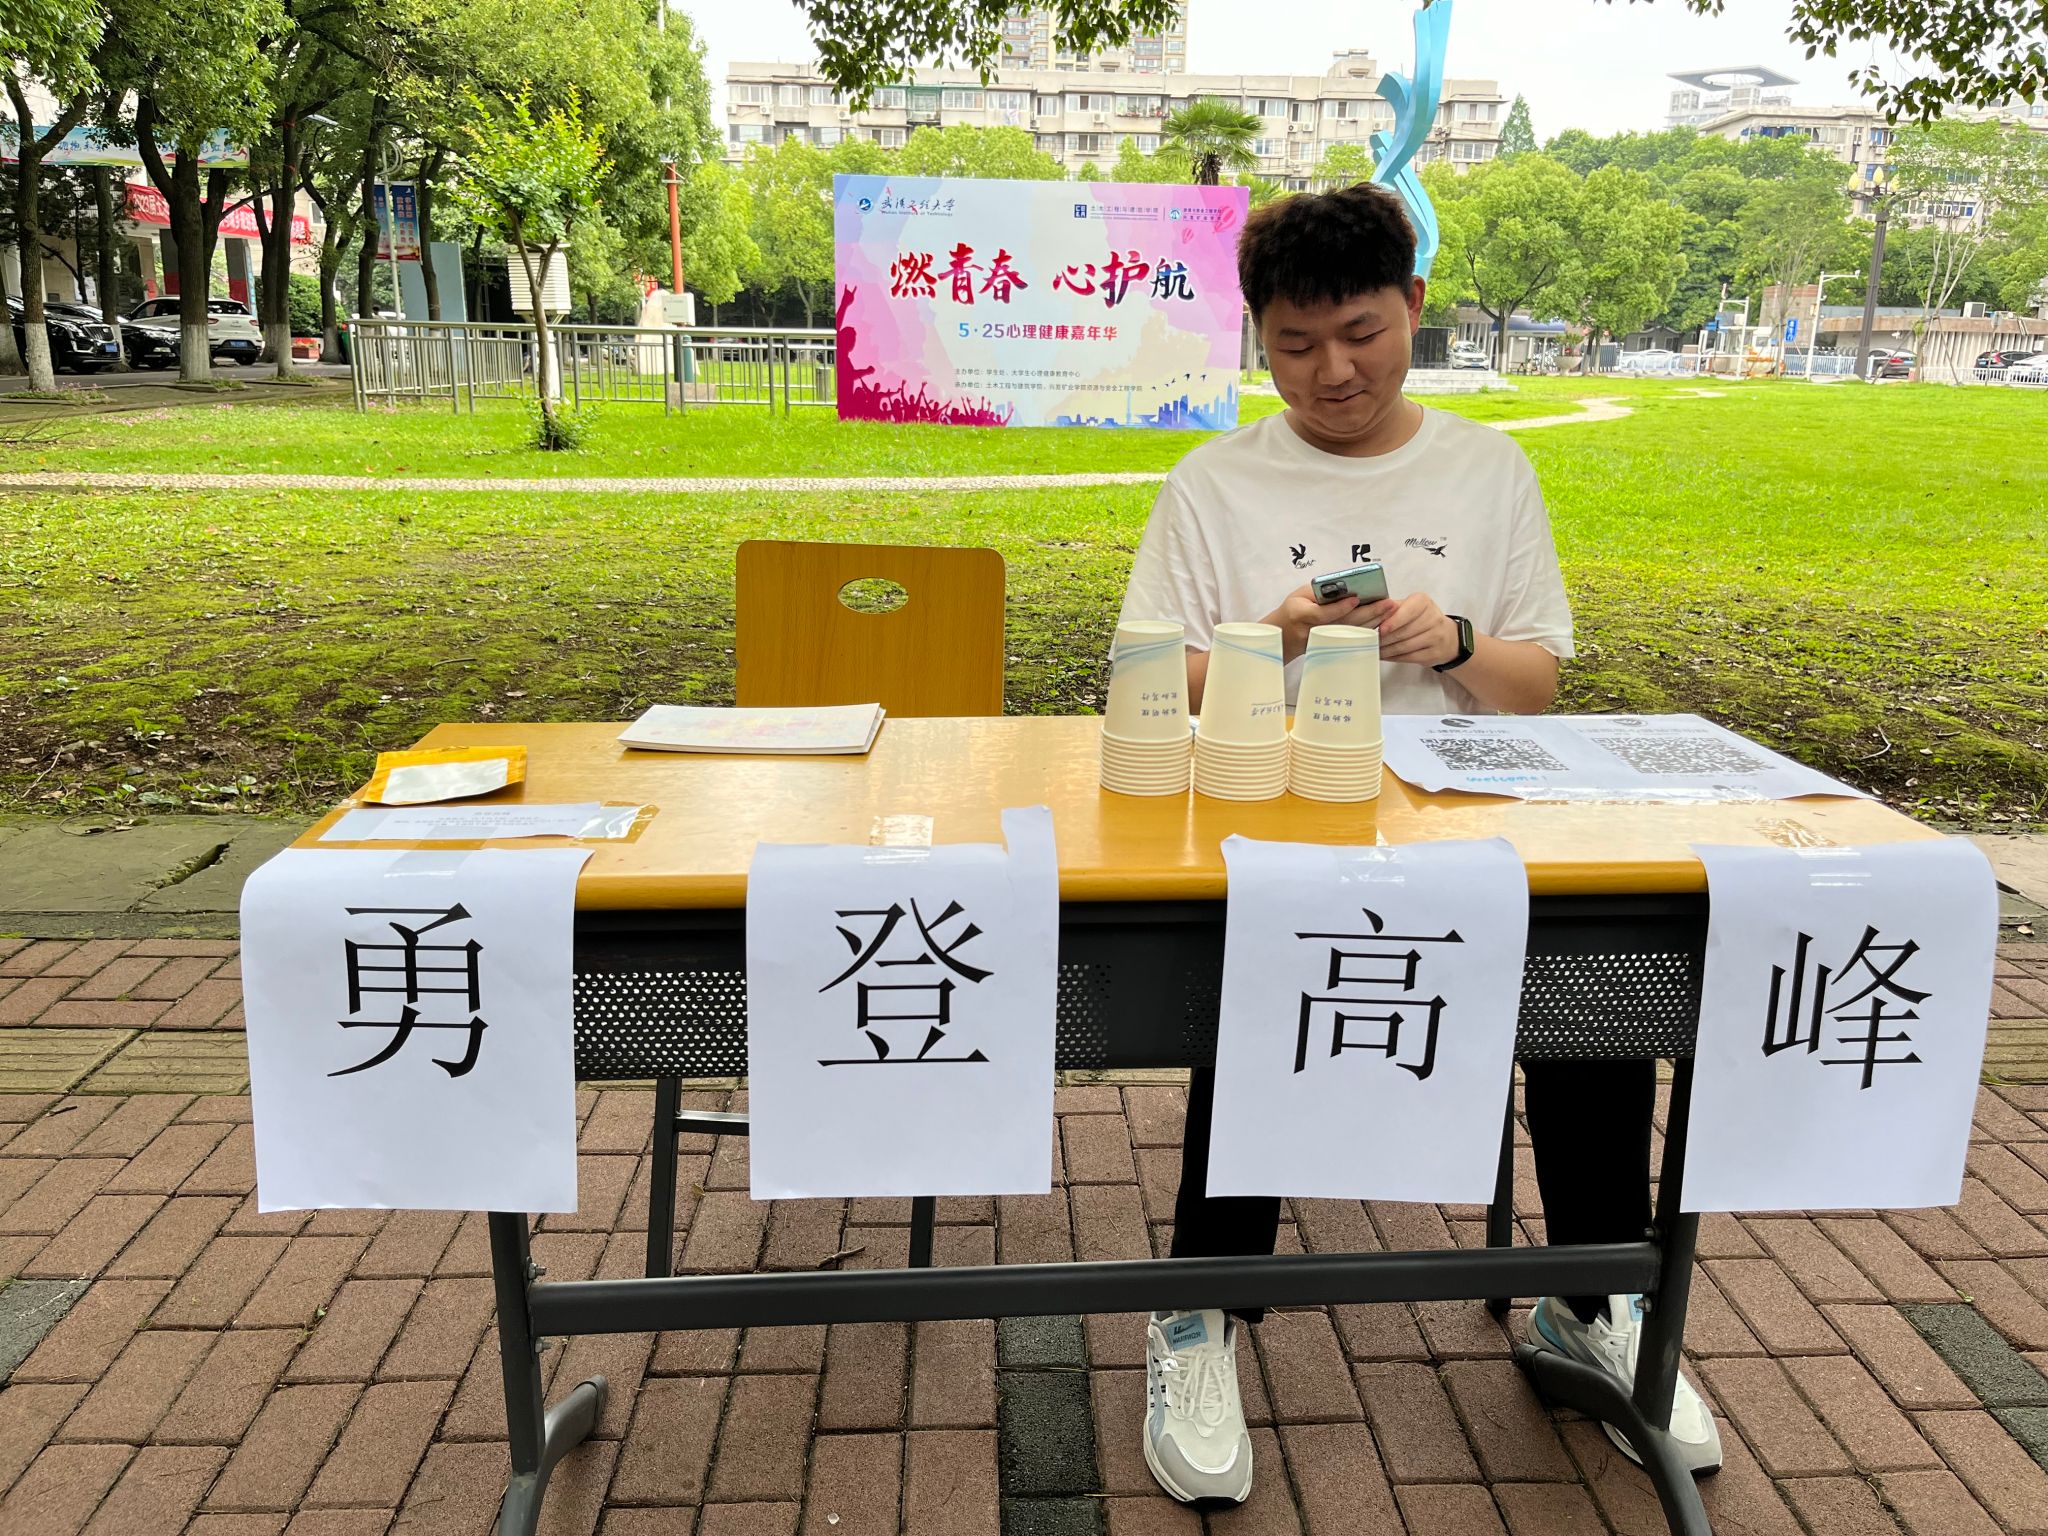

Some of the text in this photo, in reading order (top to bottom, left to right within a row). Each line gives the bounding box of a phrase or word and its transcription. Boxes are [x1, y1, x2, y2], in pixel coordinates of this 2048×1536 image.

[890, 243, 1195, 308] 燃青春 心护航
[958, 322, 1118, 341] 5·25心理健康嘉年华
[326, 896, 1933, 1090] 勇 登 高 峰
